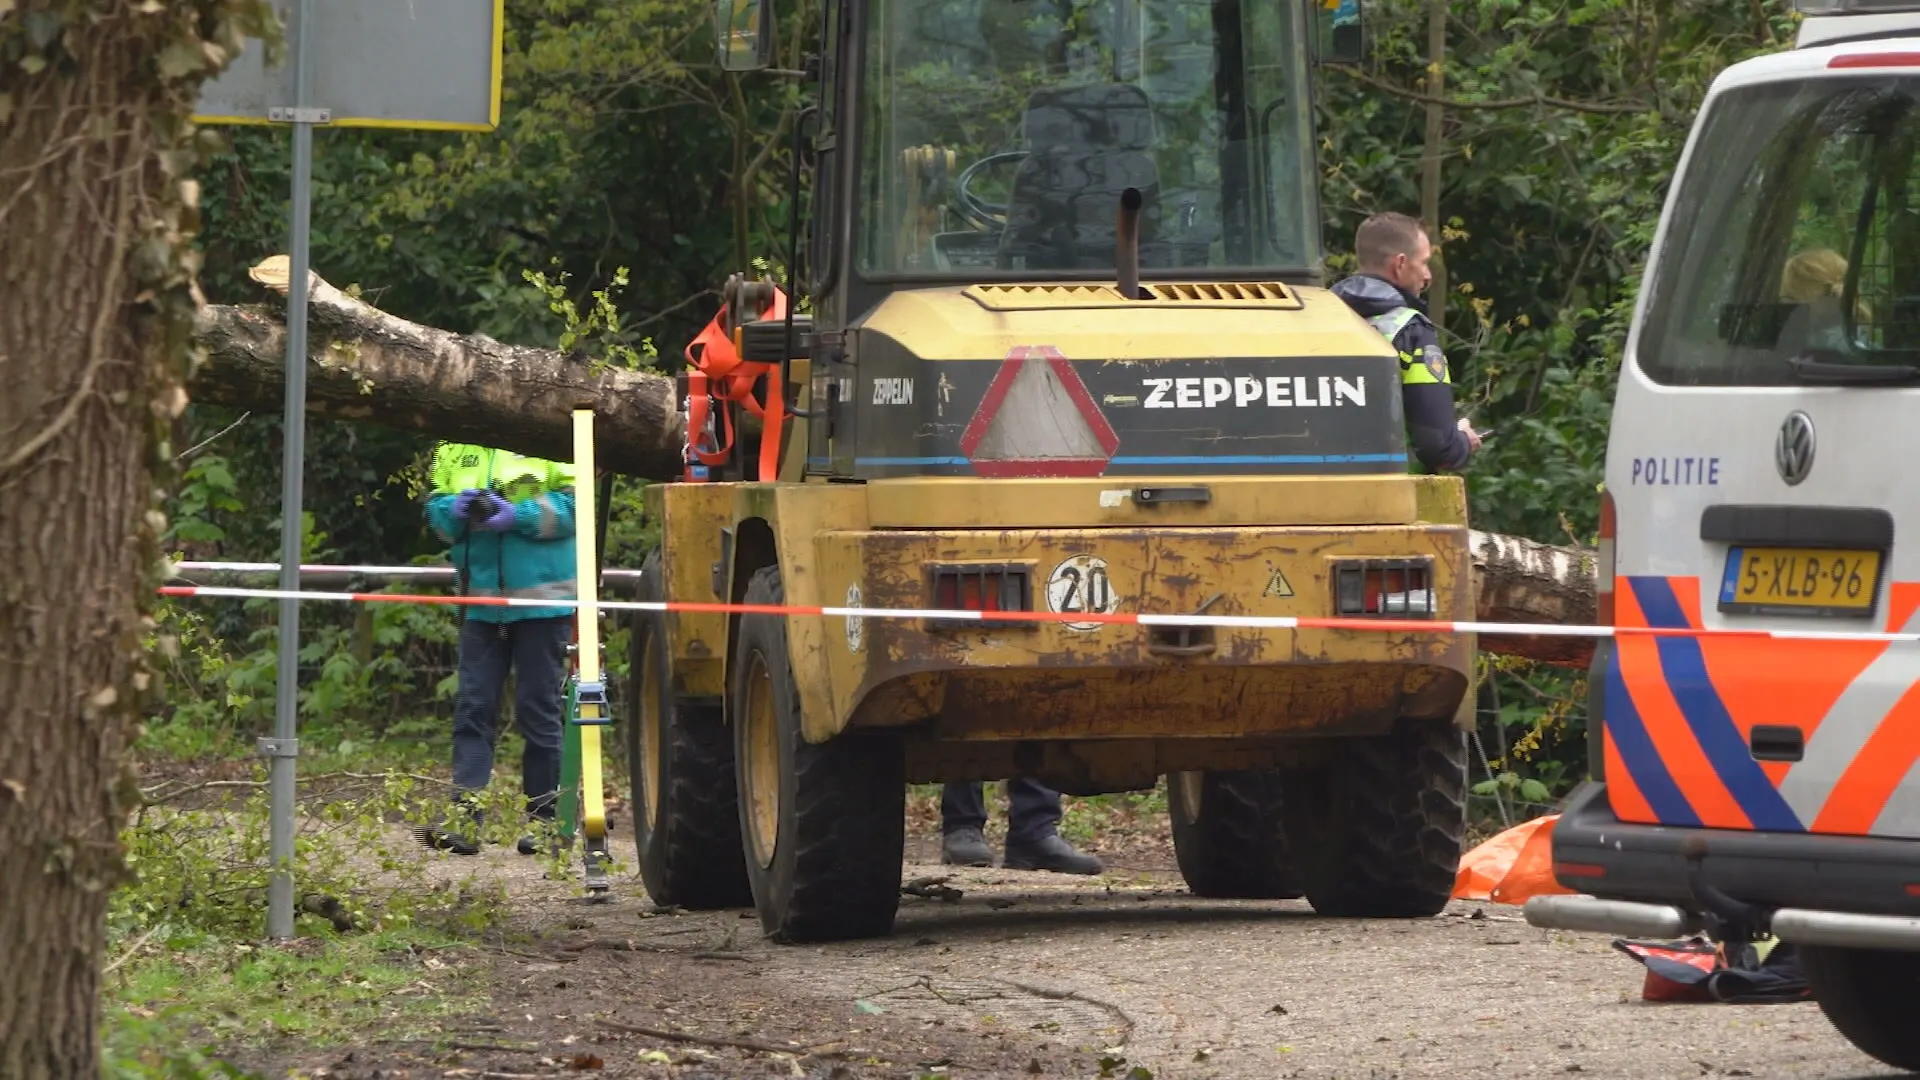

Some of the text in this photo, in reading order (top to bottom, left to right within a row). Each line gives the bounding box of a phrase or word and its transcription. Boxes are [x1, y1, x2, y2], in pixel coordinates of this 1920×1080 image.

[872, 377, 915, 405] ZEPPELIN
[1142, 375, 1366, 409] ZEPPELIN
[1632, 457, 1719, 485] POLITIE
[1061, 566, 1109, 614] 20
[1743, 556, 1863, 599] 5-XLB-96
